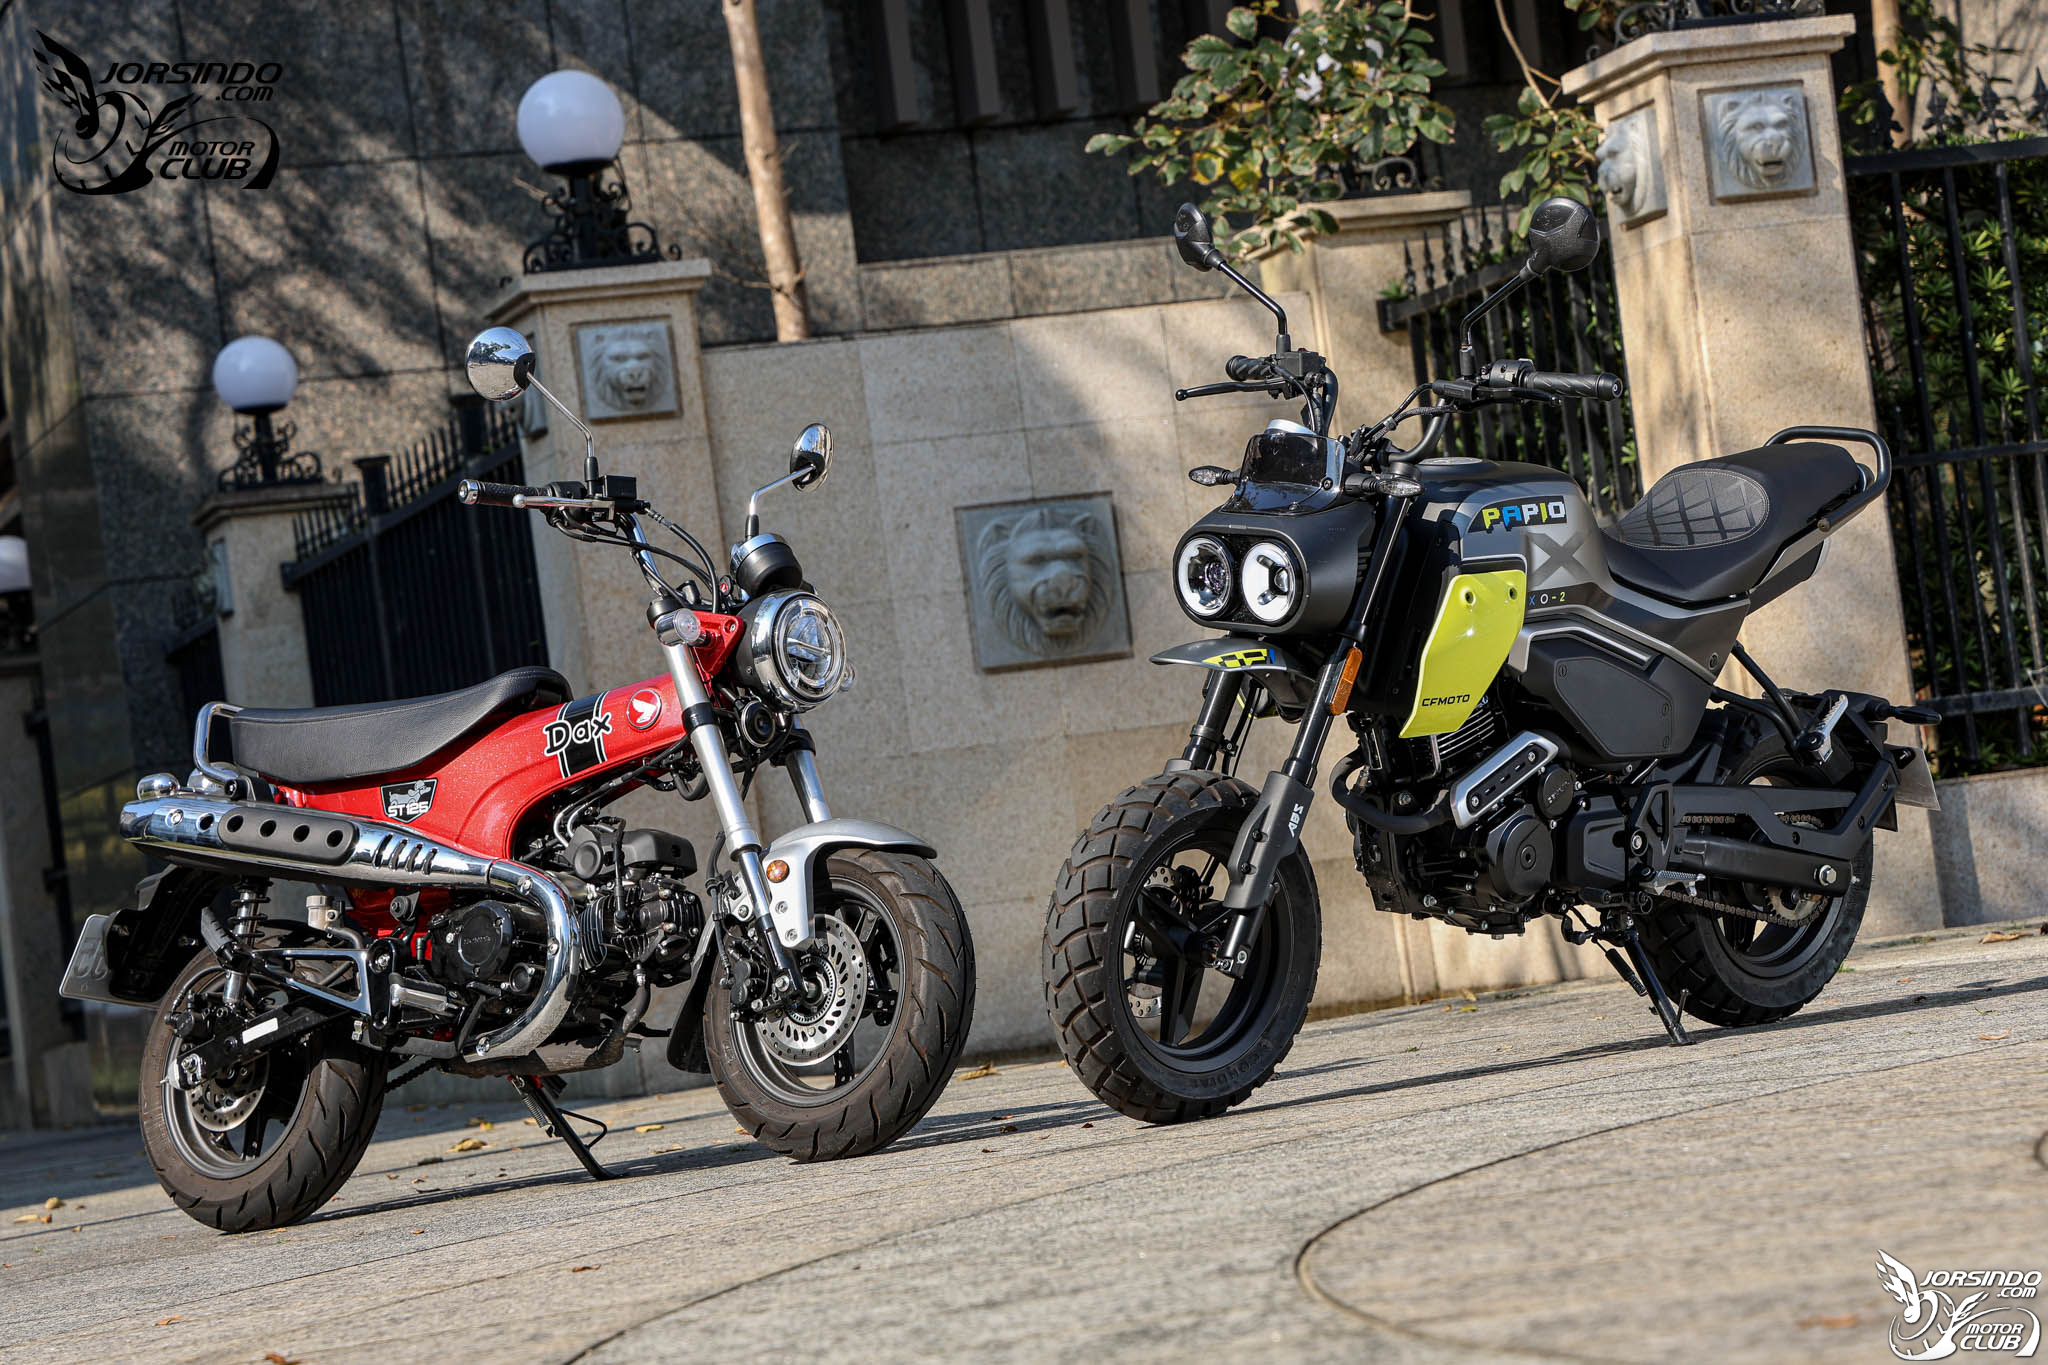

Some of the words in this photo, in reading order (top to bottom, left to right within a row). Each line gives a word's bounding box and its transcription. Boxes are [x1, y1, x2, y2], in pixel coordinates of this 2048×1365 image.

[1481, 501, 1566, 530] PAPIO
[1421, 693, 1471, 707] CFMOTO
[542, 711, 613, 757] Dax
[387, 800, 430, 818] ST125
[1288, 803, 1304, 838] ABS
